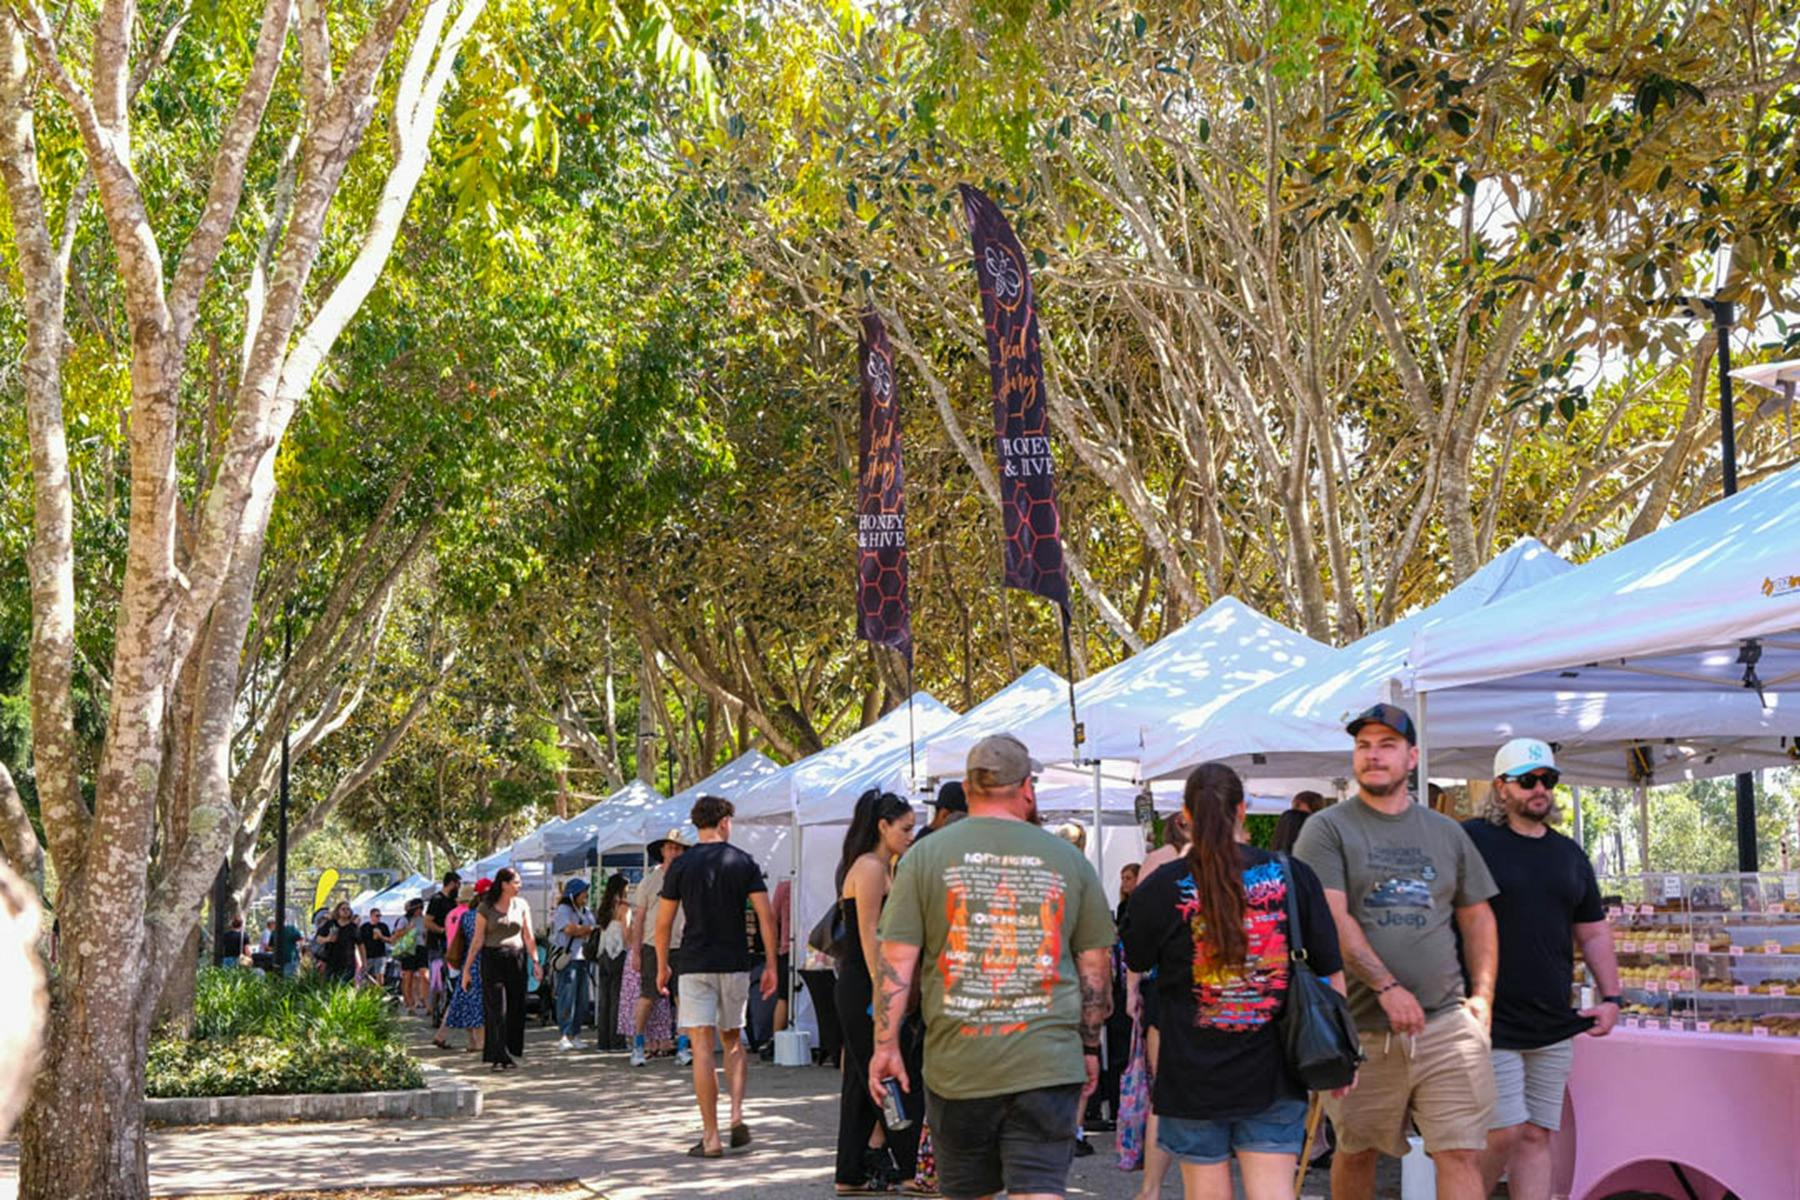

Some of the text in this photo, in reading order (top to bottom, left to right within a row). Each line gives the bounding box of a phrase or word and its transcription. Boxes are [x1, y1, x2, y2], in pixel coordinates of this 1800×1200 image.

[1004, 458, 1019, 477] &
[857, 514, 905, 530] HONEY
[869, 531, 906, 547] HIVE
[1378, 910, 1427, 928] Jeep
